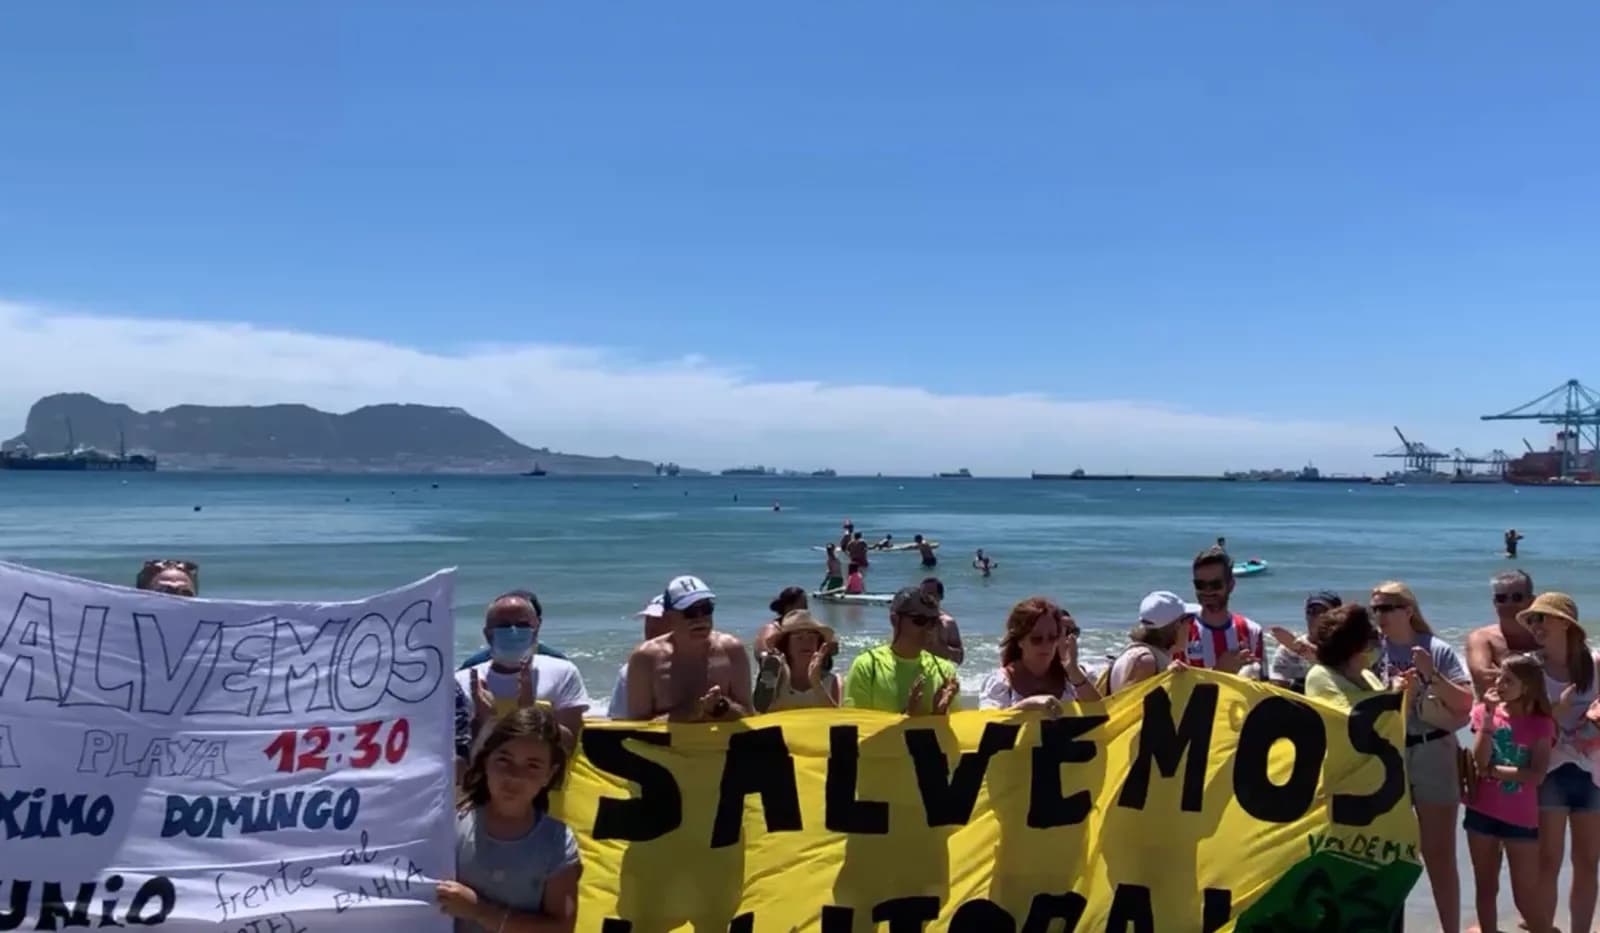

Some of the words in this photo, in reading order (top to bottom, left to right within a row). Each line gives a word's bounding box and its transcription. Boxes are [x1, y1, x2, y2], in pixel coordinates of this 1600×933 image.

[77, 729, 229, 779] PLAYA
[264, 717, 410, 773] 12:30
[582, 683, 1405, 848] SALVEMOS
[215, 861, 318, 923] frente
[340, 830, 379, 866] al
